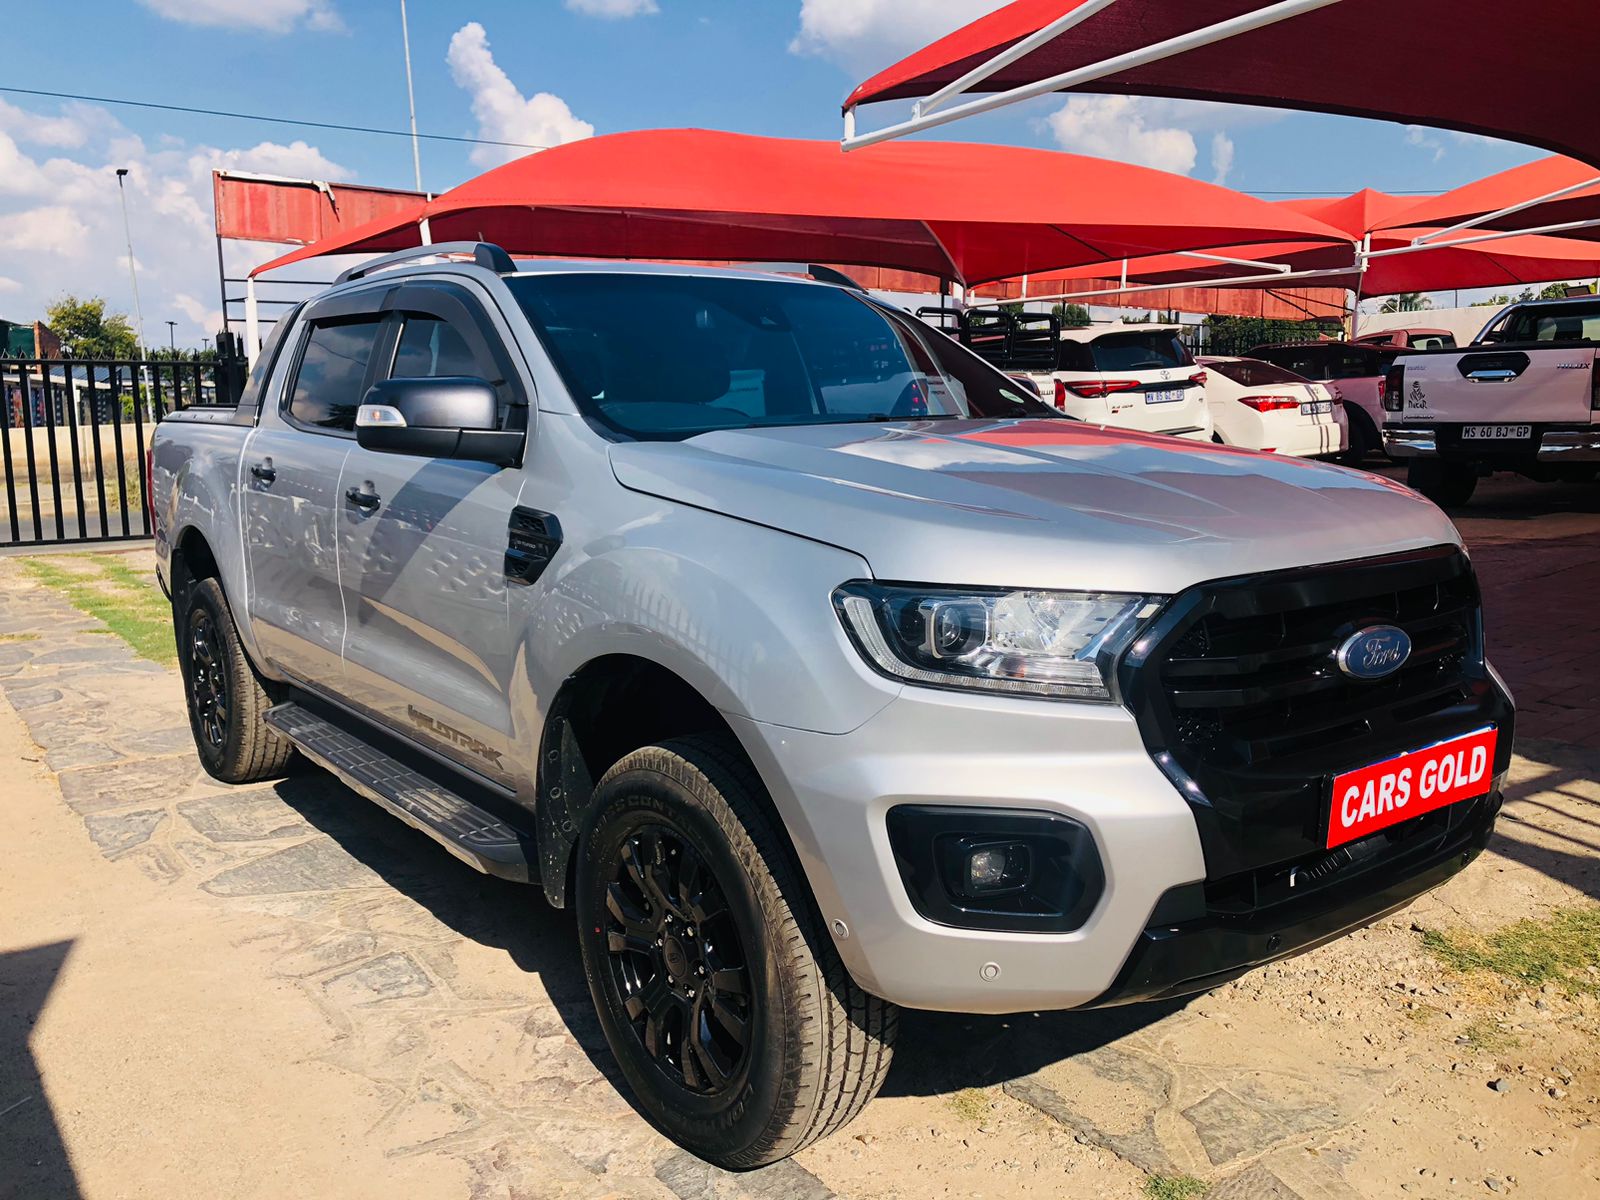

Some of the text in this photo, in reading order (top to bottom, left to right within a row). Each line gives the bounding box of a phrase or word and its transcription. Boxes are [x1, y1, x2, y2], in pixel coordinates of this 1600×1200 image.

[1464, 426, 1529, 437] MS 60 BJ GP
[1363, 636, 1400, 668] Ford
